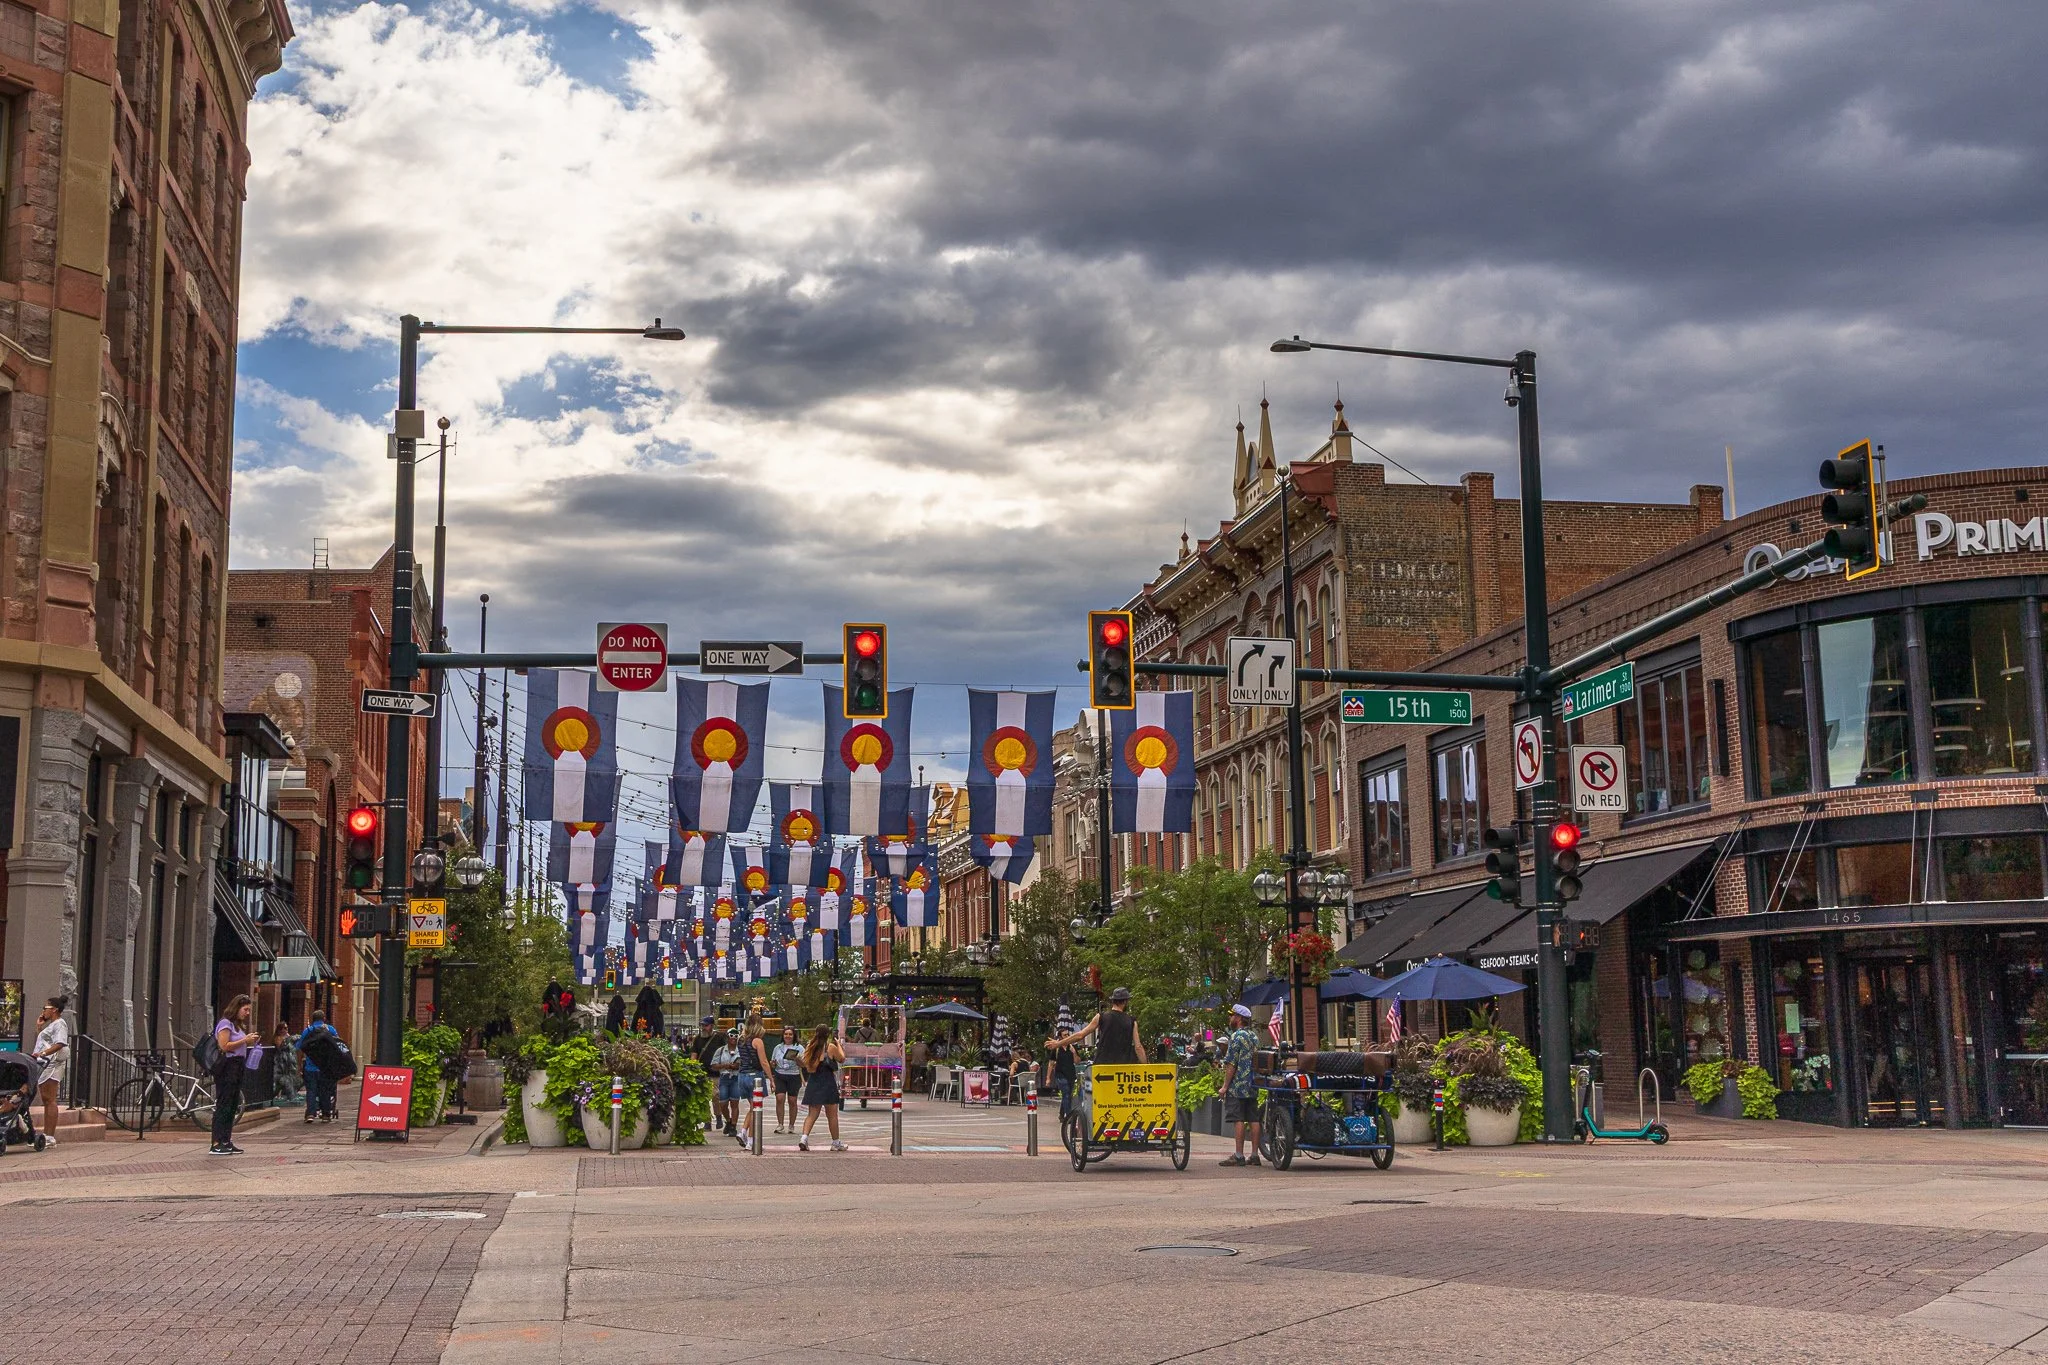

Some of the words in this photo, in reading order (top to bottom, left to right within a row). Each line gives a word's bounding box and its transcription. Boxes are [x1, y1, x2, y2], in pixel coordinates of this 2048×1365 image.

[1914, 512, 2048, 562] PRIM
[608, 636, 626, 648] DO
[632, 636, 658, 648] NOT
[708, 651, 735, 664] ONE
[741, 651, 769, 664] WAY
[612, 667, 652, 679] ENTER
[1232, 689, 1258, 700] ONLY
[1264, 690, 1290, 701] ONLY
[1576, 679, 1617, 711] Larimer
[1622, 671, 1628, 682] St
[370, 697, 390, 706] ONE
[393, 699, 414, 708] WAY
[1388, 697, 1431, 717] 15th
[1453, 698, 1462, 708] St
[1449, 709, 1467, 719] 1500
[1580, 794, 1595, 806] ON
[1600, 794, 1621, 807] RED
[1824, 911, 1861, 923] 1465
[1479, 956, 1505, 969] SEAFOOD
[1509, 954, 1530, 966] STEAKS
[1115, 1072, 1140, 1083] This
[1143, 1071, 1155, 1082] is
[1117, 1083, 1124, 1094] 3
[1128, 1083, 1152, 1094] feet
